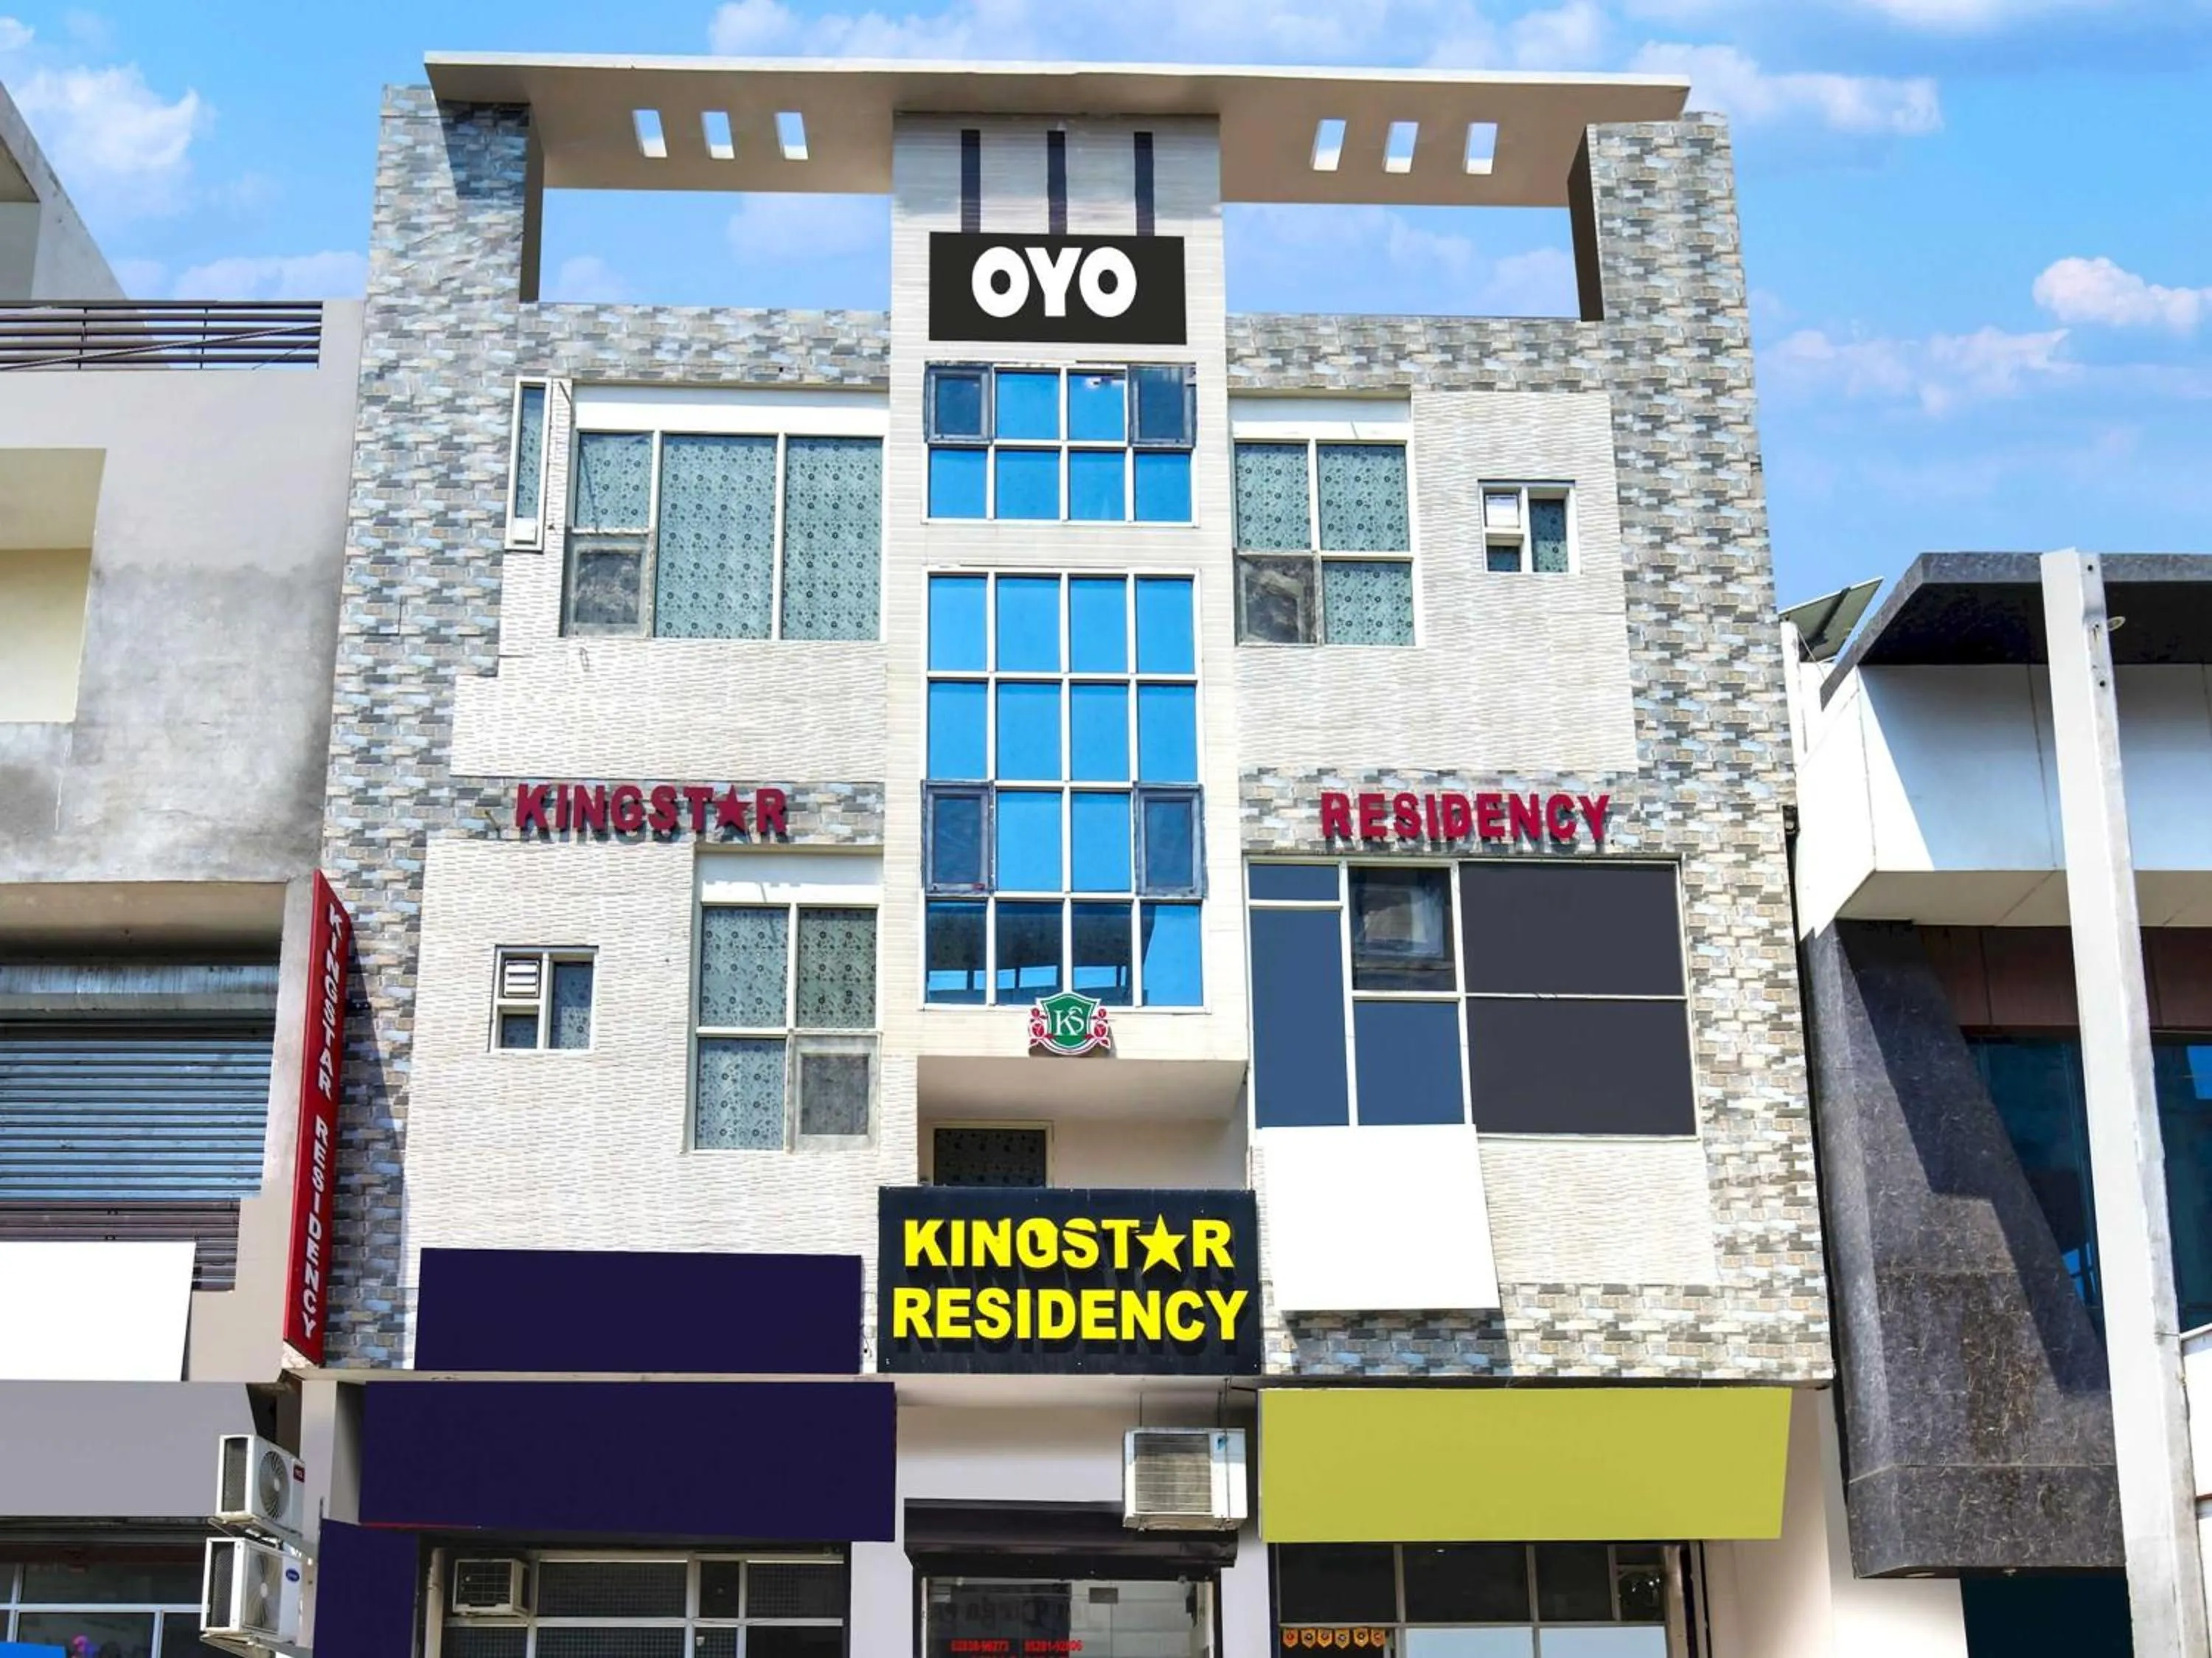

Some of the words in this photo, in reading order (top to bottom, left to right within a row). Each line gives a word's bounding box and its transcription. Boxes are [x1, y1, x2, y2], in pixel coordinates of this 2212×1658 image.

[972, 246, 1137, 318] OYO
[1321, 791, 1610, 842] RESIDENCY
[318, 902, 343, 1101] KINGSTAR
[302, 1114, 328, 1339] RESIDENCY
[893, 1287, 1249, 1341] RESIDENCY
